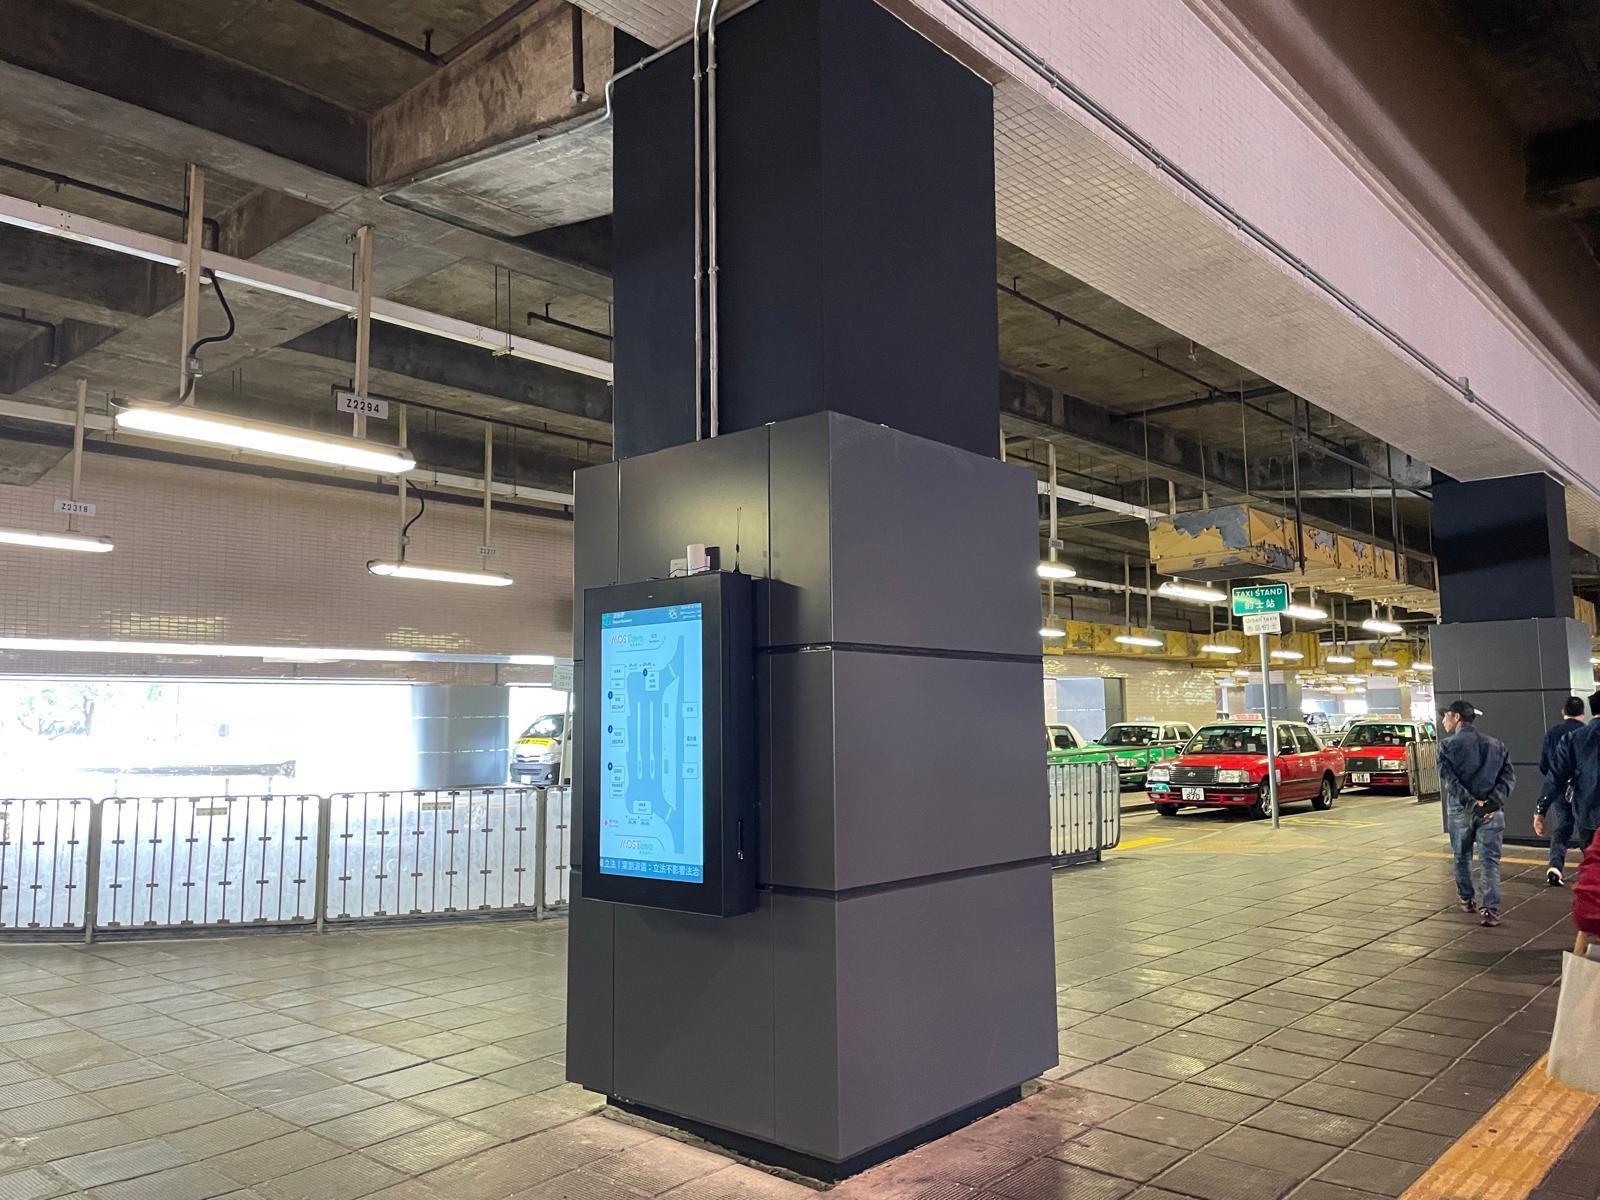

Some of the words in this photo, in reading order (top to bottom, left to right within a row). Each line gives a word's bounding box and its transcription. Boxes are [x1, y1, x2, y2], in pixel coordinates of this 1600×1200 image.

[346, 398, 379, 413] Z2294
[1255, 588, 1282, 597] STAND
[1245, 598, 1275, 610] 的士站
